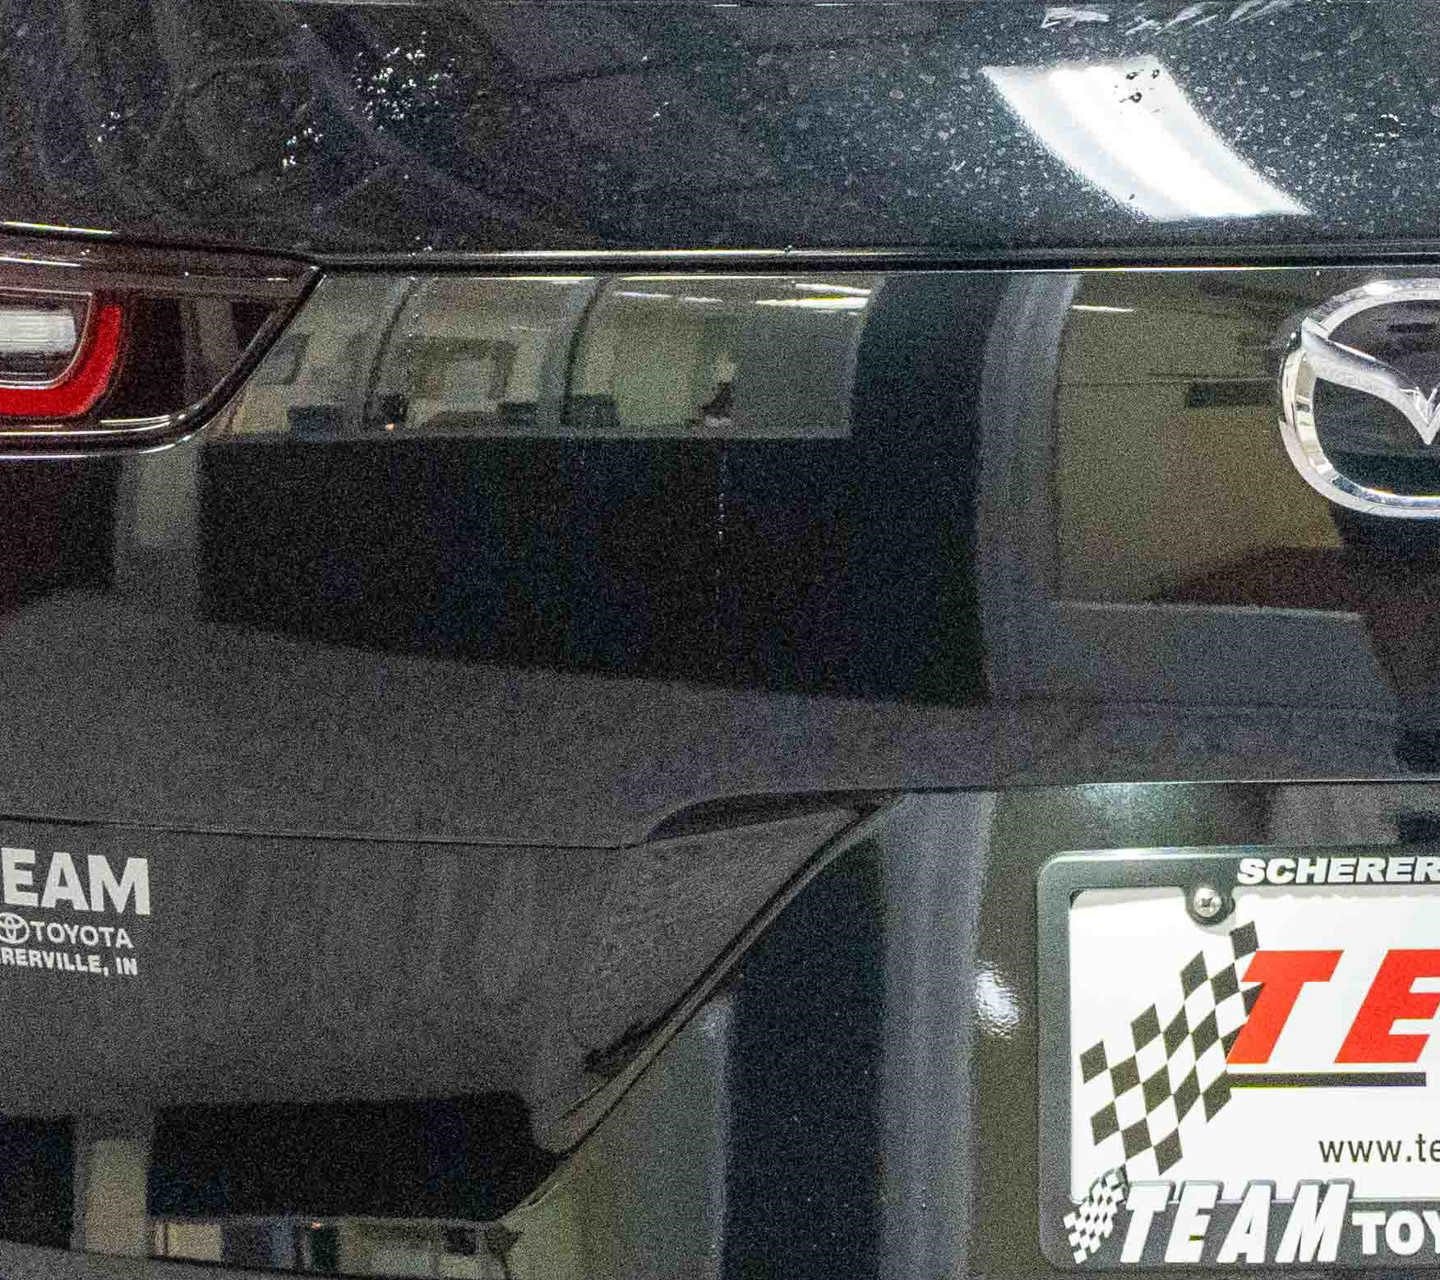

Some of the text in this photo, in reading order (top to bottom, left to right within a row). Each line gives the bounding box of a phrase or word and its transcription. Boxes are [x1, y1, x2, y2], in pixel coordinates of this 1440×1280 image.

[29, 920, 135, 949] TOYOTA
[115, 956, 139, 976] IN
[1121, 1180, 1354, 1265] TEAM
